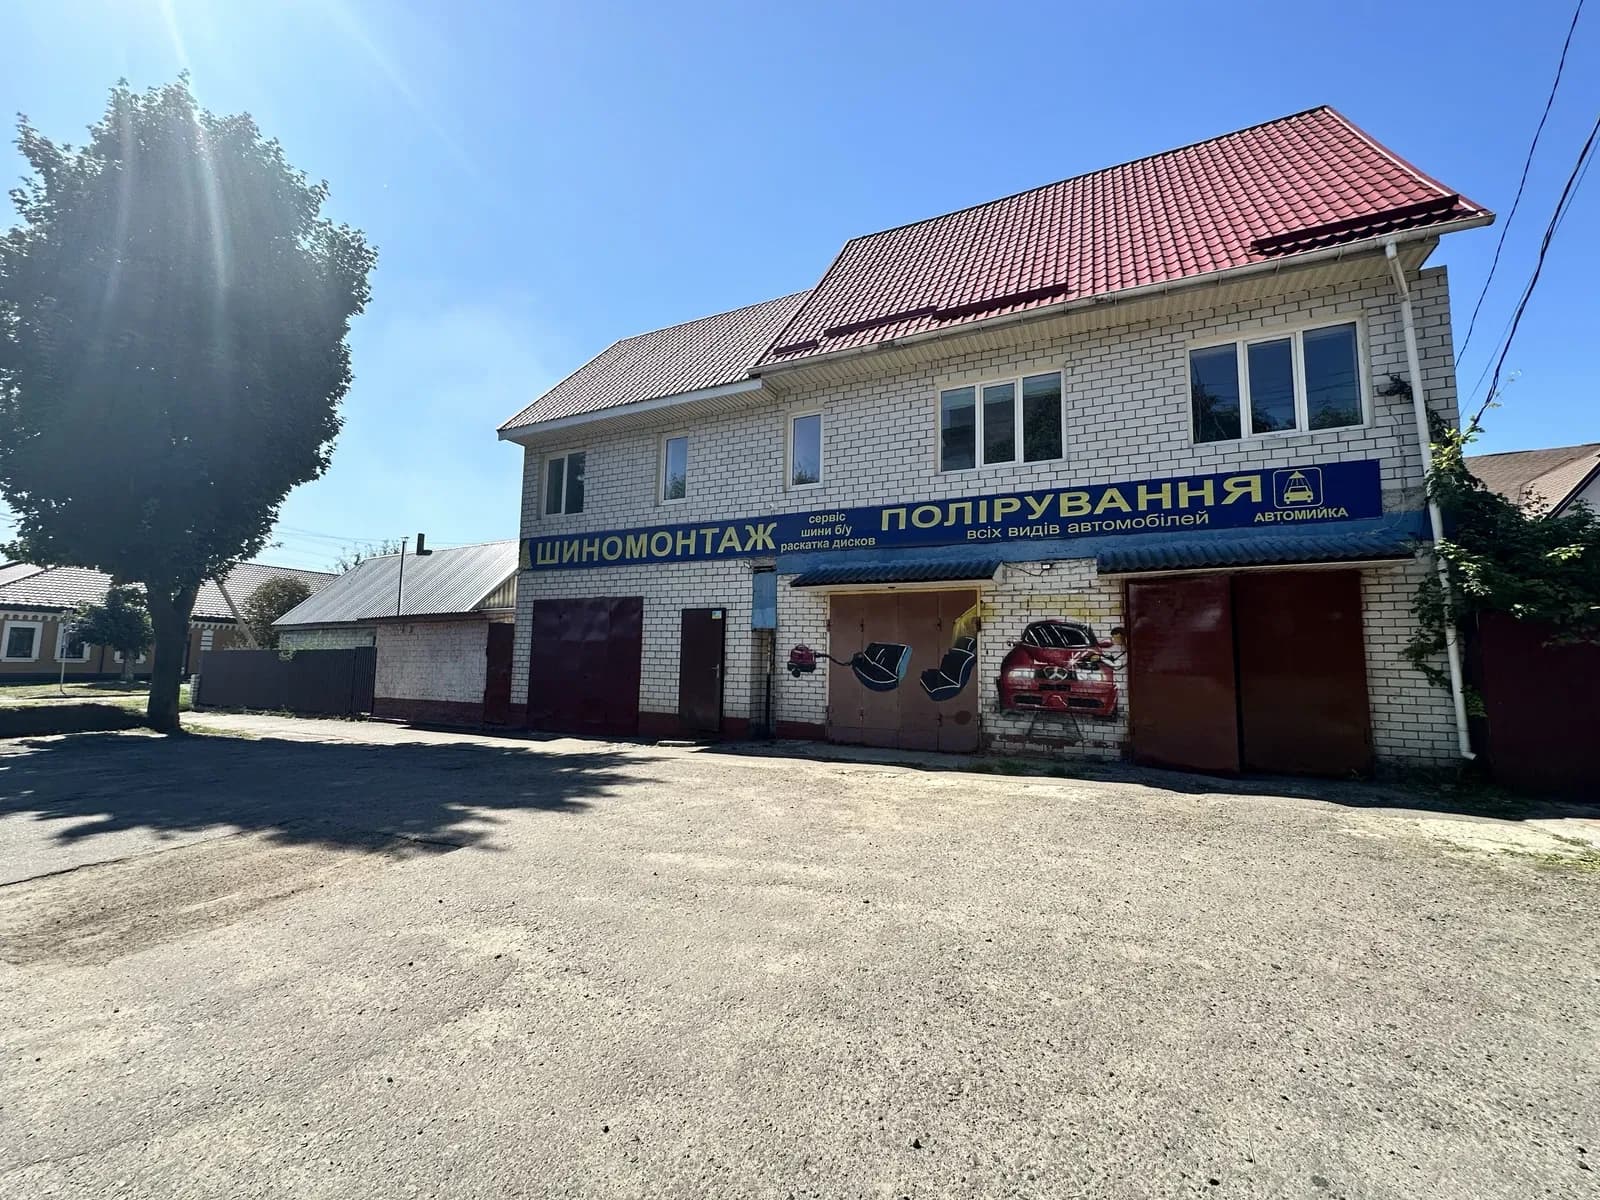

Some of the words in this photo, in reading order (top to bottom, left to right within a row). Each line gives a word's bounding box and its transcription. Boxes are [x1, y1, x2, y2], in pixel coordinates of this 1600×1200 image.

[881, 475, 1262, 531] ПОЛІРУВАННЯ
[809, 512, 846, 525] сервіс
[1254, 507, 1349, 522] АВТОМИЙКА
[801, 527, 831, 537] шини
[834, 524, 853, 537] б/у
[967, 526, 1002, 540] всіх
[1008, 522, 1060, 538] видів
[1068, 510, 1209, 534] автомобілей
[536, 522, 778, 565] ШИНОМОНТАЖ
[781, 540, 829, 553] раскатка
[832, 537, 876, 549] дисков
